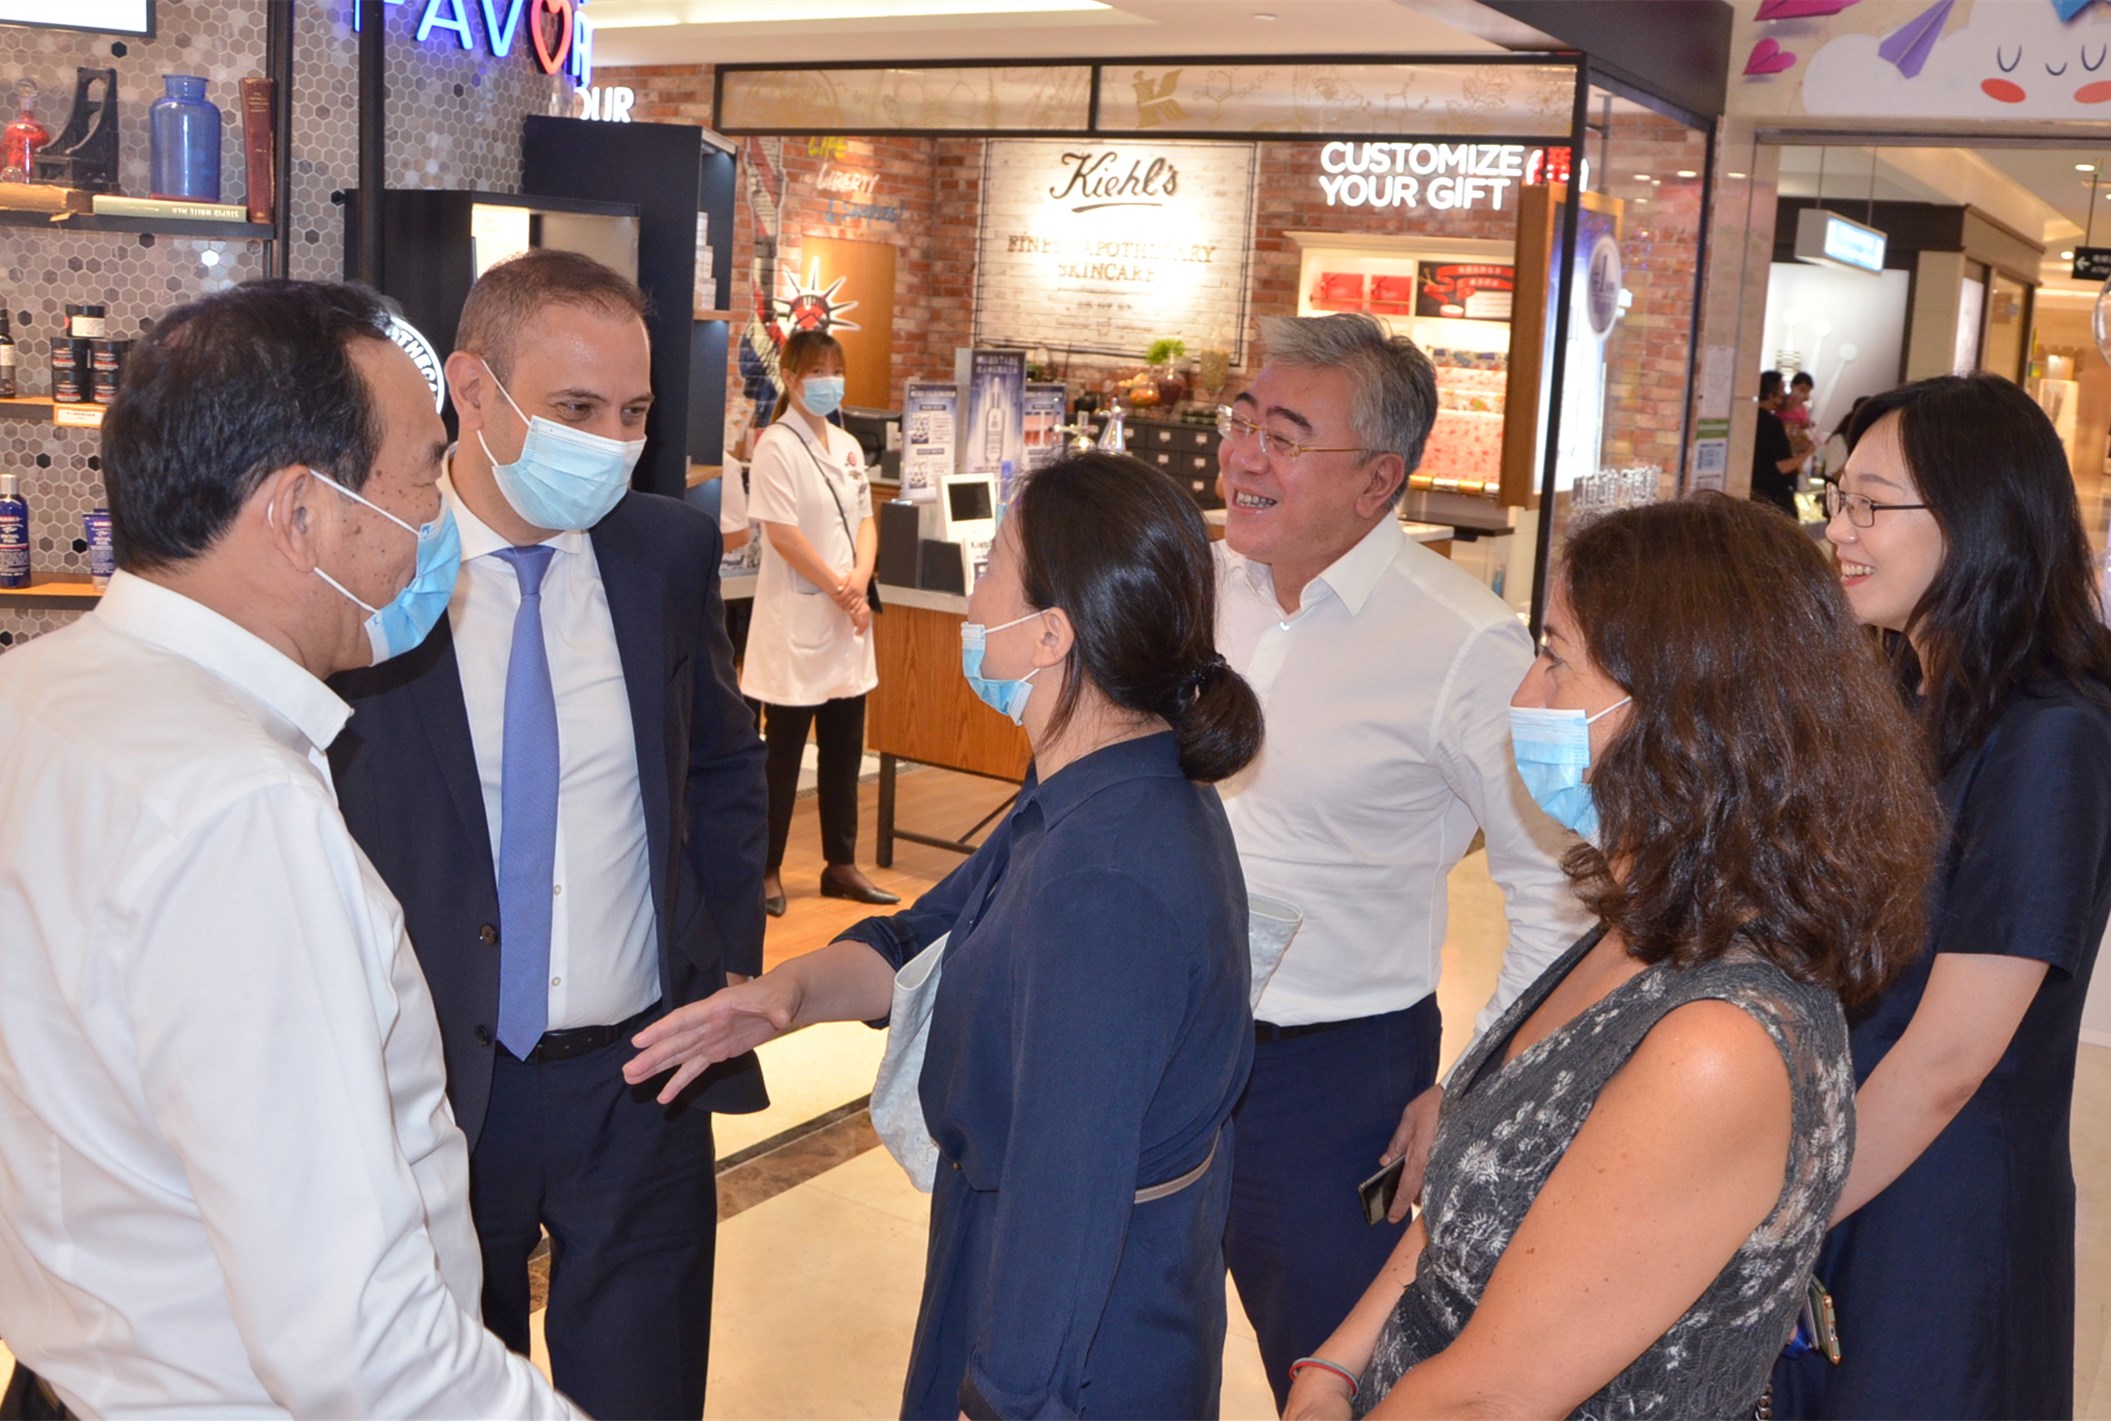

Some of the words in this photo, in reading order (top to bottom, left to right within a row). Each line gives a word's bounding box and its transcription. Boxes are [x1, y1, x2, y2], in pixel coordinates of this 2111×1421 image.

[1049, 151, 1179, 200] Kiehl's
[1320, 142, 1525, 177] CUSTOMIZE
[1318, 174, 1418, 209] YOUR
[1426, 176, 1512, 211] GIFT
